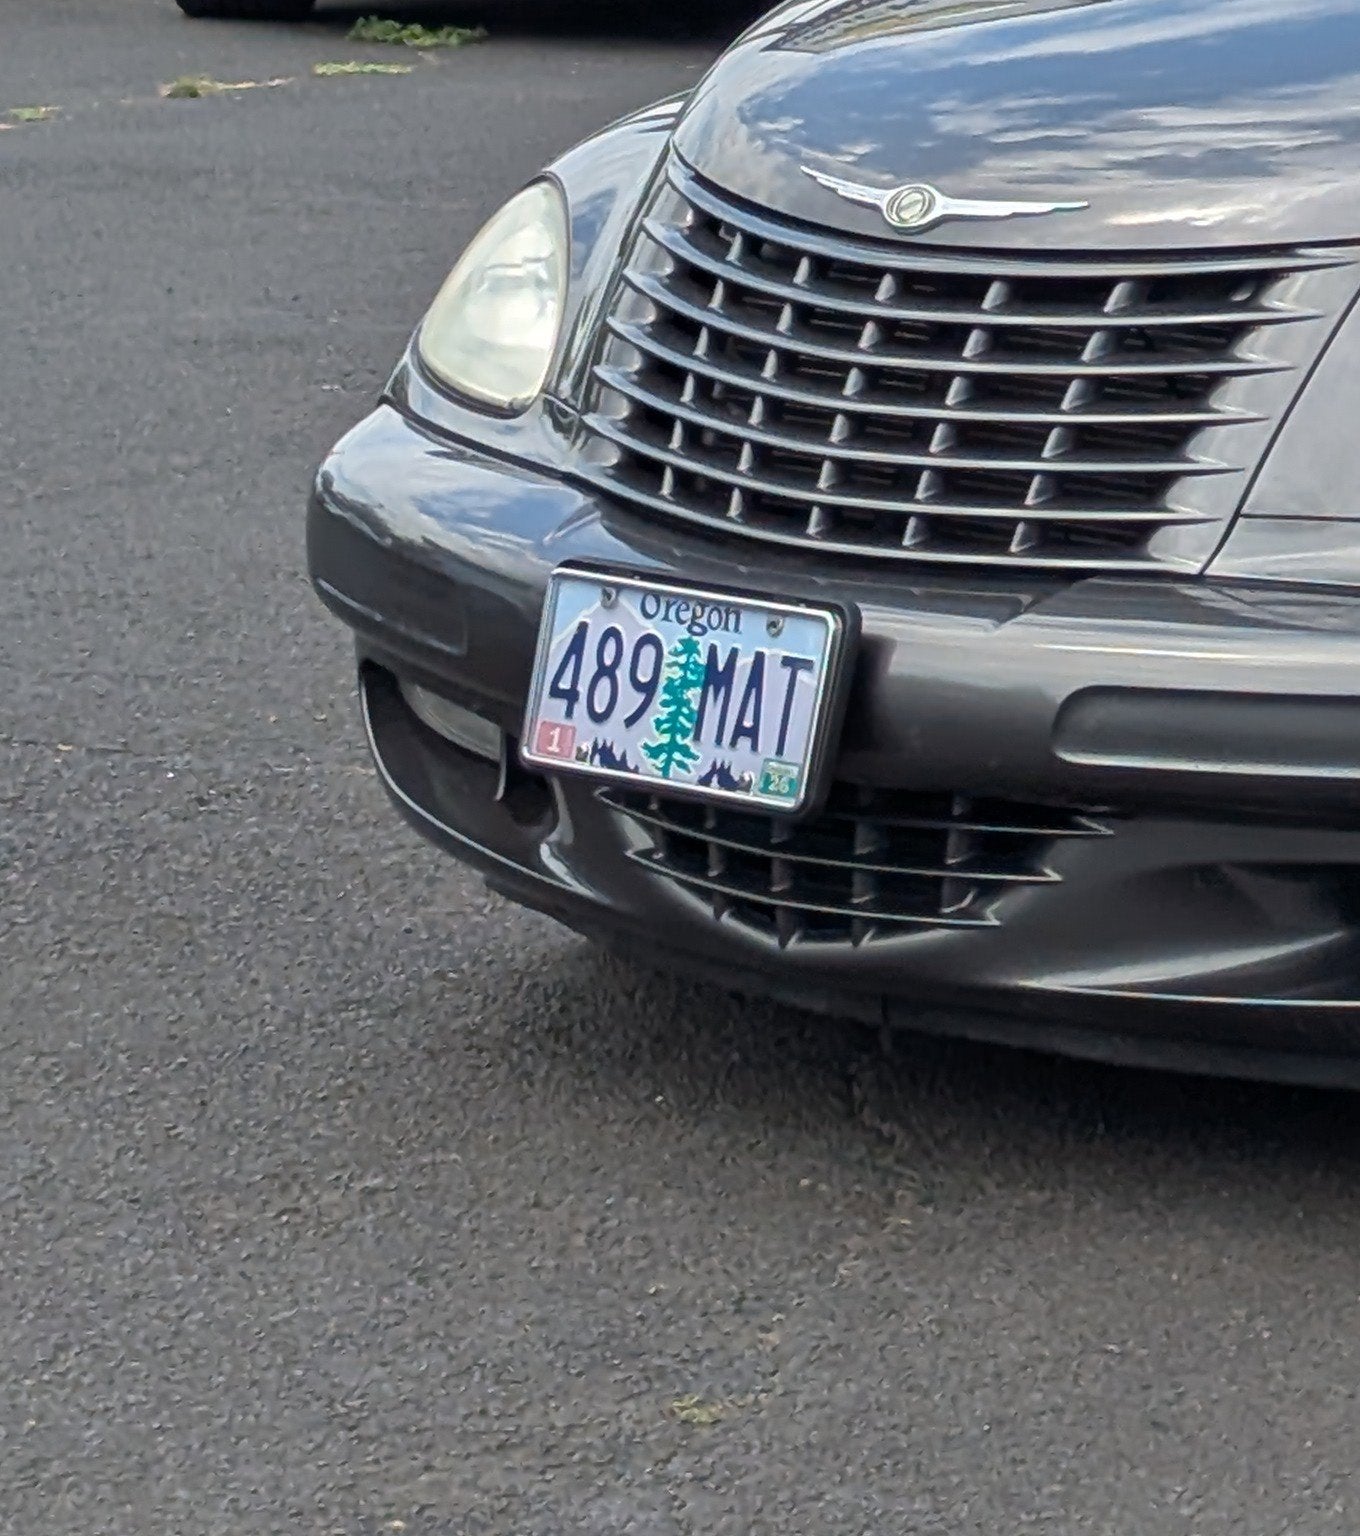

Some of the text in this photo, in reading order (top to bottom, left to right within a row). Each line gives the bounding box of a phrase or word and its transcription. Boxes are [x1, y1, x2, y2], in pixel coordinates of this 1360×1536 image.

[640, 592, 743, 637] Oregon
[549, 620, 815, 757] 489 MAT
[548, 731, 561, 754] 1
